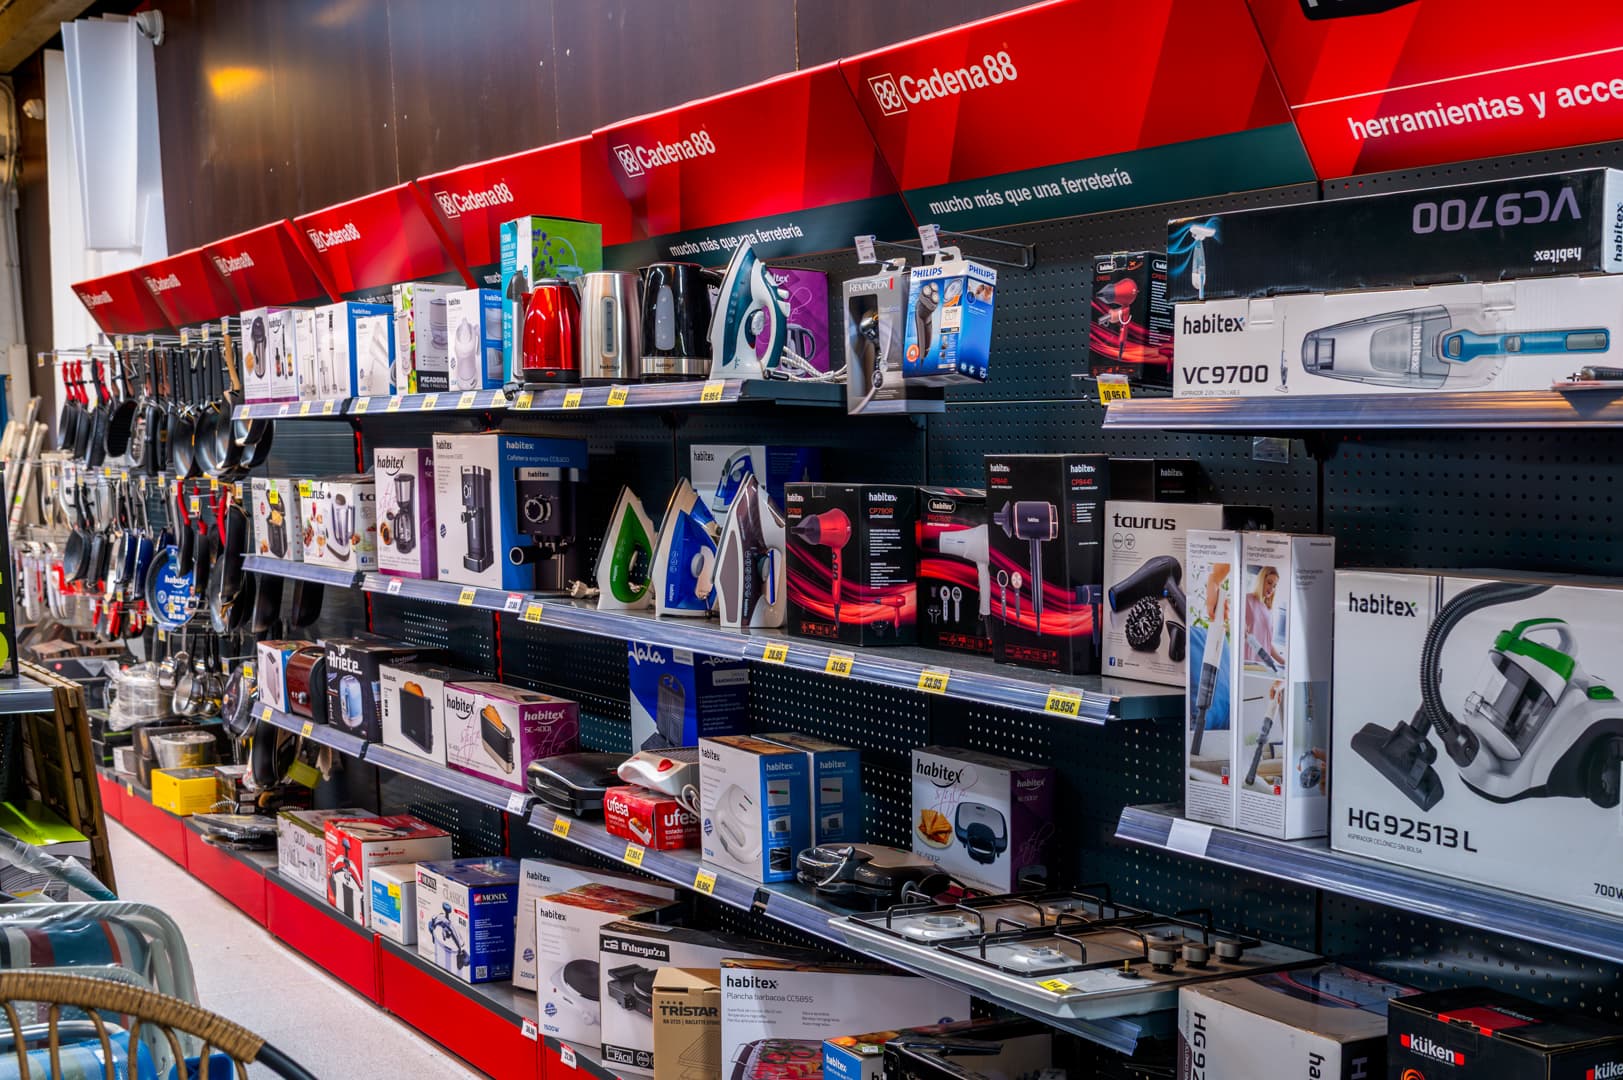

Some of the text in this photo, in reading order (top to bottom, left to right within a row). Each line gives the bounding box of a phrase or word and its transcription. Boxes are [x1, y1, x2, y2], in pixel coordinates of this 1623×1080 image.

[1347, 95, 1524, 141] herramientas
[1530, 92, 1548, 119] y
[929, 167, 1133, 215] mucho más que una ferretería
[1412, 187, 1582, 234] VC9700
[669, 240, 700, 257] mucho
[699, 236, 720, 252] más
[719, 233, 738, 252] que
[757, 222, 804, 244] ferretería
[1534, 247, 1582, 264] habitex
[912, 267, 942, 278] PHILIPS
[968, 264, 996, 281] PHILIPS
[849, 281, 888, 293] REMINGTON
[1183, 313, 1244, 335] habitex
[1182, 364, 1269, 385] VC9700
[436, 440, 452, 450] habitex
[506, 440, 535, 450] habitex
[377, 456, 405, 469] habitex
[694, 450, 714, 462] habitex
[1070, 463, 1097, 474] habitex
[1160, 468, 1183, 478] habitex
[869, 491, 899, 502] habitex
[1112, 513, 1178, 531] taurus
[1348, 592, 1417, 617] habitex
[327, 651, 362, 676] Ariete
[446, 693, 476, 715] habitex
[524, 709, 566, 722] habitex
[701, 748, 721, 762] habitex
[766, 761, 793, 773] habitex
[820, 760, 847, 770] habitex
[916, 759, 964, 784] habitex
[607, 797, 629, 817] ufesa
[527, 871, 551, 882] habitex
[482, 892, 508, 901] MONIX
[540, 908, 567, 921] habitex
[727, 975, 778, 990] habitex
[727, 992, 753, 1001] Plancha
[754, 993, 786, 1002] barbacoa
[1411, 1034, 1455, 1064] küken
[826, 1053, 848, 1073] habitex
